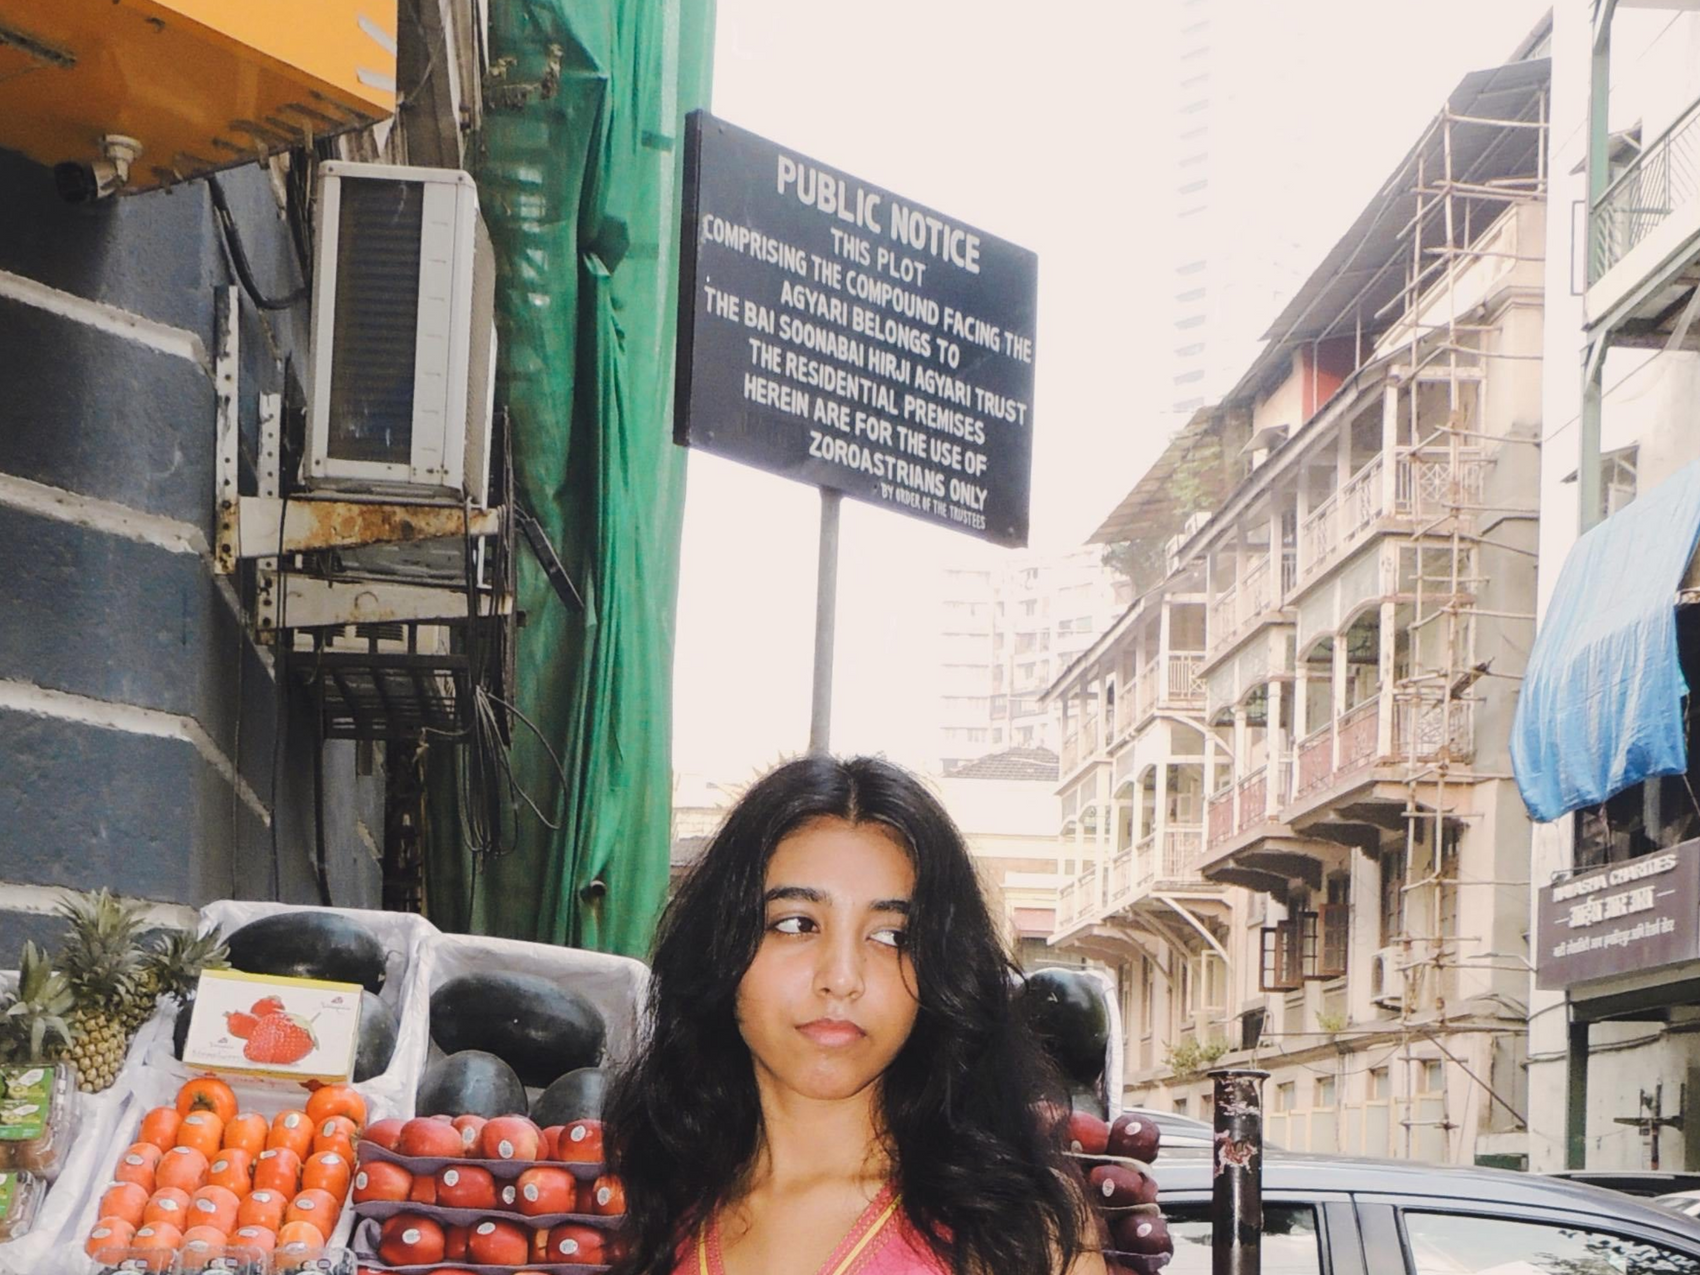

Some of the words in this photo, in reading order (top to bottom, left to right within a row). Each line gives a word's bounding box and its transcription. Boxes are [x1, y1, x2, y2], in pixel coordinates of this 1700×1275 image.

[777, 154, 881, 234] PUBLIC
[890, 202, 980, 274] NOTICE
[830, 226, 870, 266] THIS
[877, 246, 926, 287] PLOT
[702, 213, 807, 277] COMPRISING
[811, 254, 842, 290] THE
[846, 270, 939, 326] COMPOUND
[943, 307, 1000, 352] FACING
[1004, 331, 1032, 363] THE
[780, 280, 848, 327] AGYARI
[852, 306, 931, 357] BELONGS
[936, 337, 960, 369] TO
[704, 285, 739, 322] THE
[744, 300, 775, 334] BAI
[779, 314, 864, 367] SOONABAI
[868, 347, 911, 384] HIRJI
[915, 365, 971, 407] AGYARI
[975, 387, 1027, 426] TRUST
[749, 338, 782, 374] THE
[785, 351, 899, 415] RESIDENTIAL
[904, 394, 986, 445] PREMISES
[743, 372, 809, 418] HEREIN
[813, 398, 851, 433] ARE
[854, 411, 892, 446] FOR
[897, 426, 927, 459] THE
[930, 438, 961, 470] USE
[964, 451, 987, 477] OF
[808, 430, 945, 497] ZOROASTRIANS
[949, 478, 988, 511] ONLY
[880, 482, 894, 500] BY
[895, 487, 920, 510] ORDER
[922, 496, 931, 513] OF
[932, 499, 947, 518] THE
[949, 504, 986, 530] TRUSTEES
